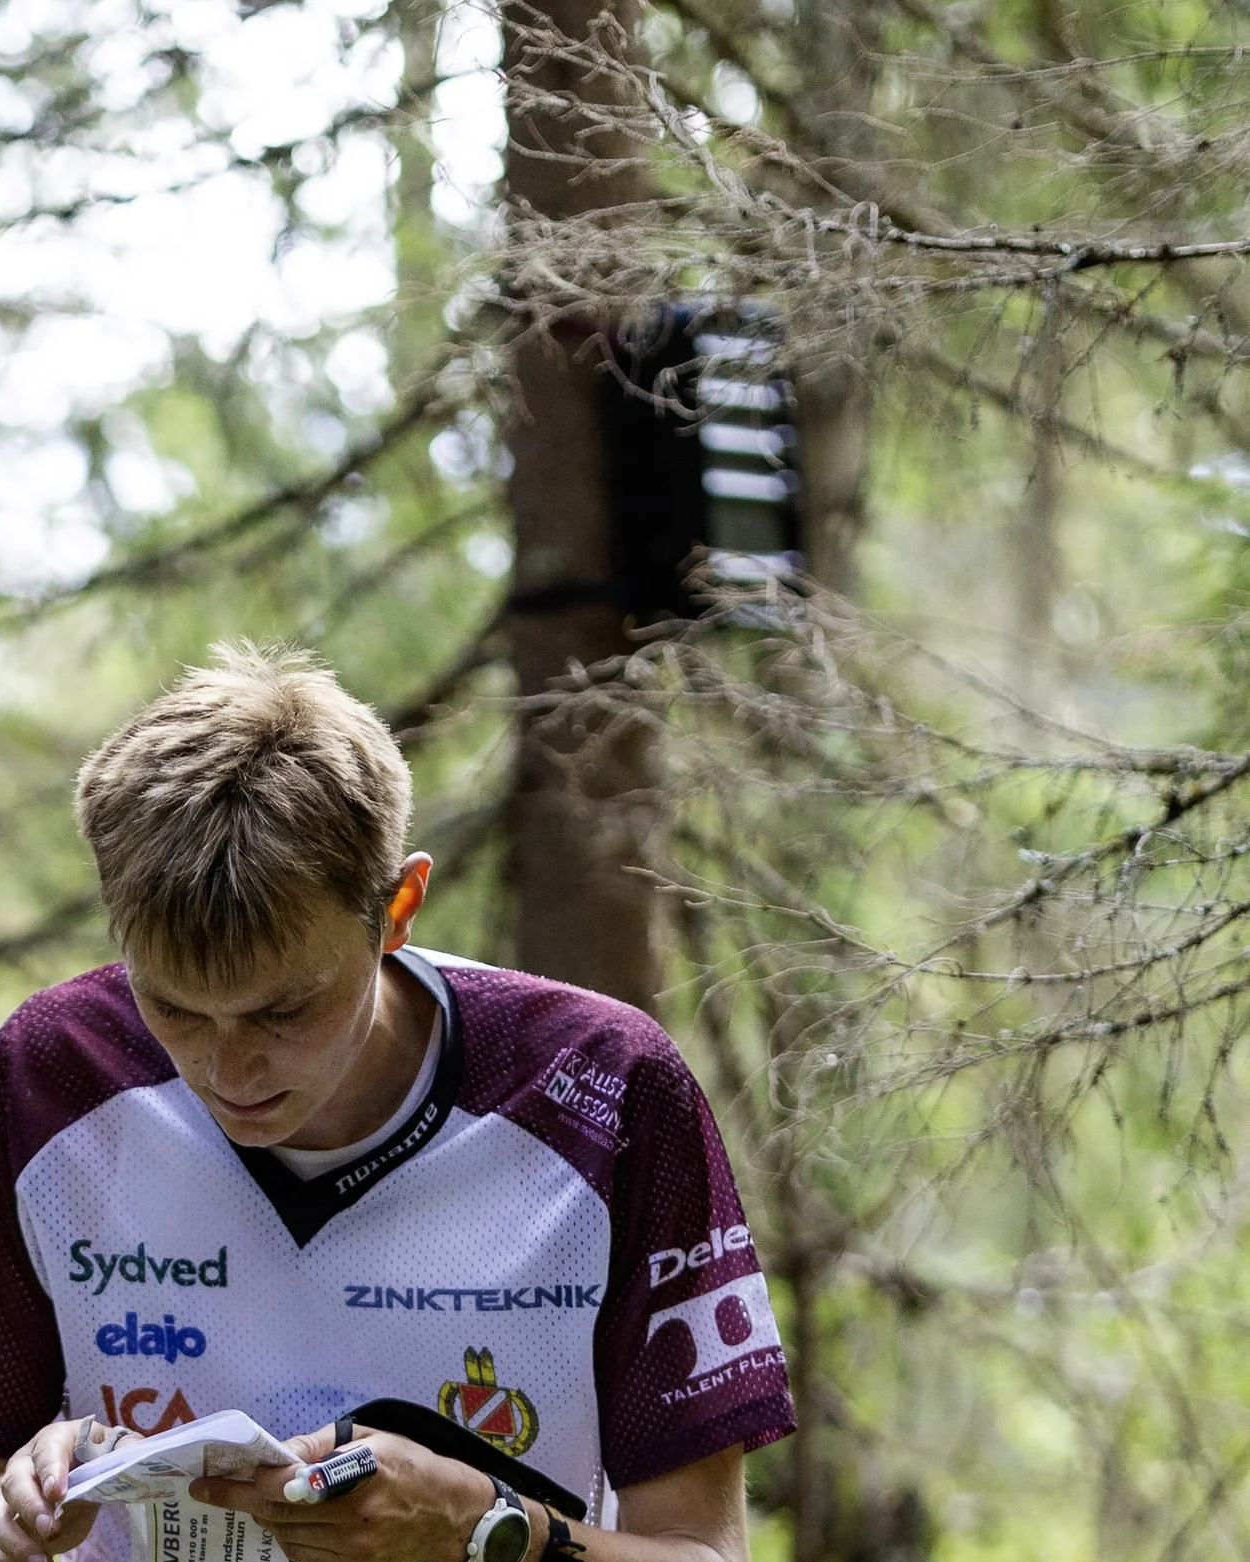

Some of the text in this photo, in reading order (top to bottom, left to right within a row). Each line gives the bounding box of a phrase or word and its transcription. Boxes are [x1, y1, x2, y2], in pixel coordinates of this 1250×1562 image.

[69, 1239, 228, 1296] Sydved
[648, 1223, 754, 1288] Dele
[344, 1284, 601, 1311] ZINKTEKNIK
[96, 1312, 206, 1364] elajo
[102, 1384, 198, 1438] ICA
[661, 1367, 734, 1405] TALENT
[190, 1518, 199, 1539] 000
